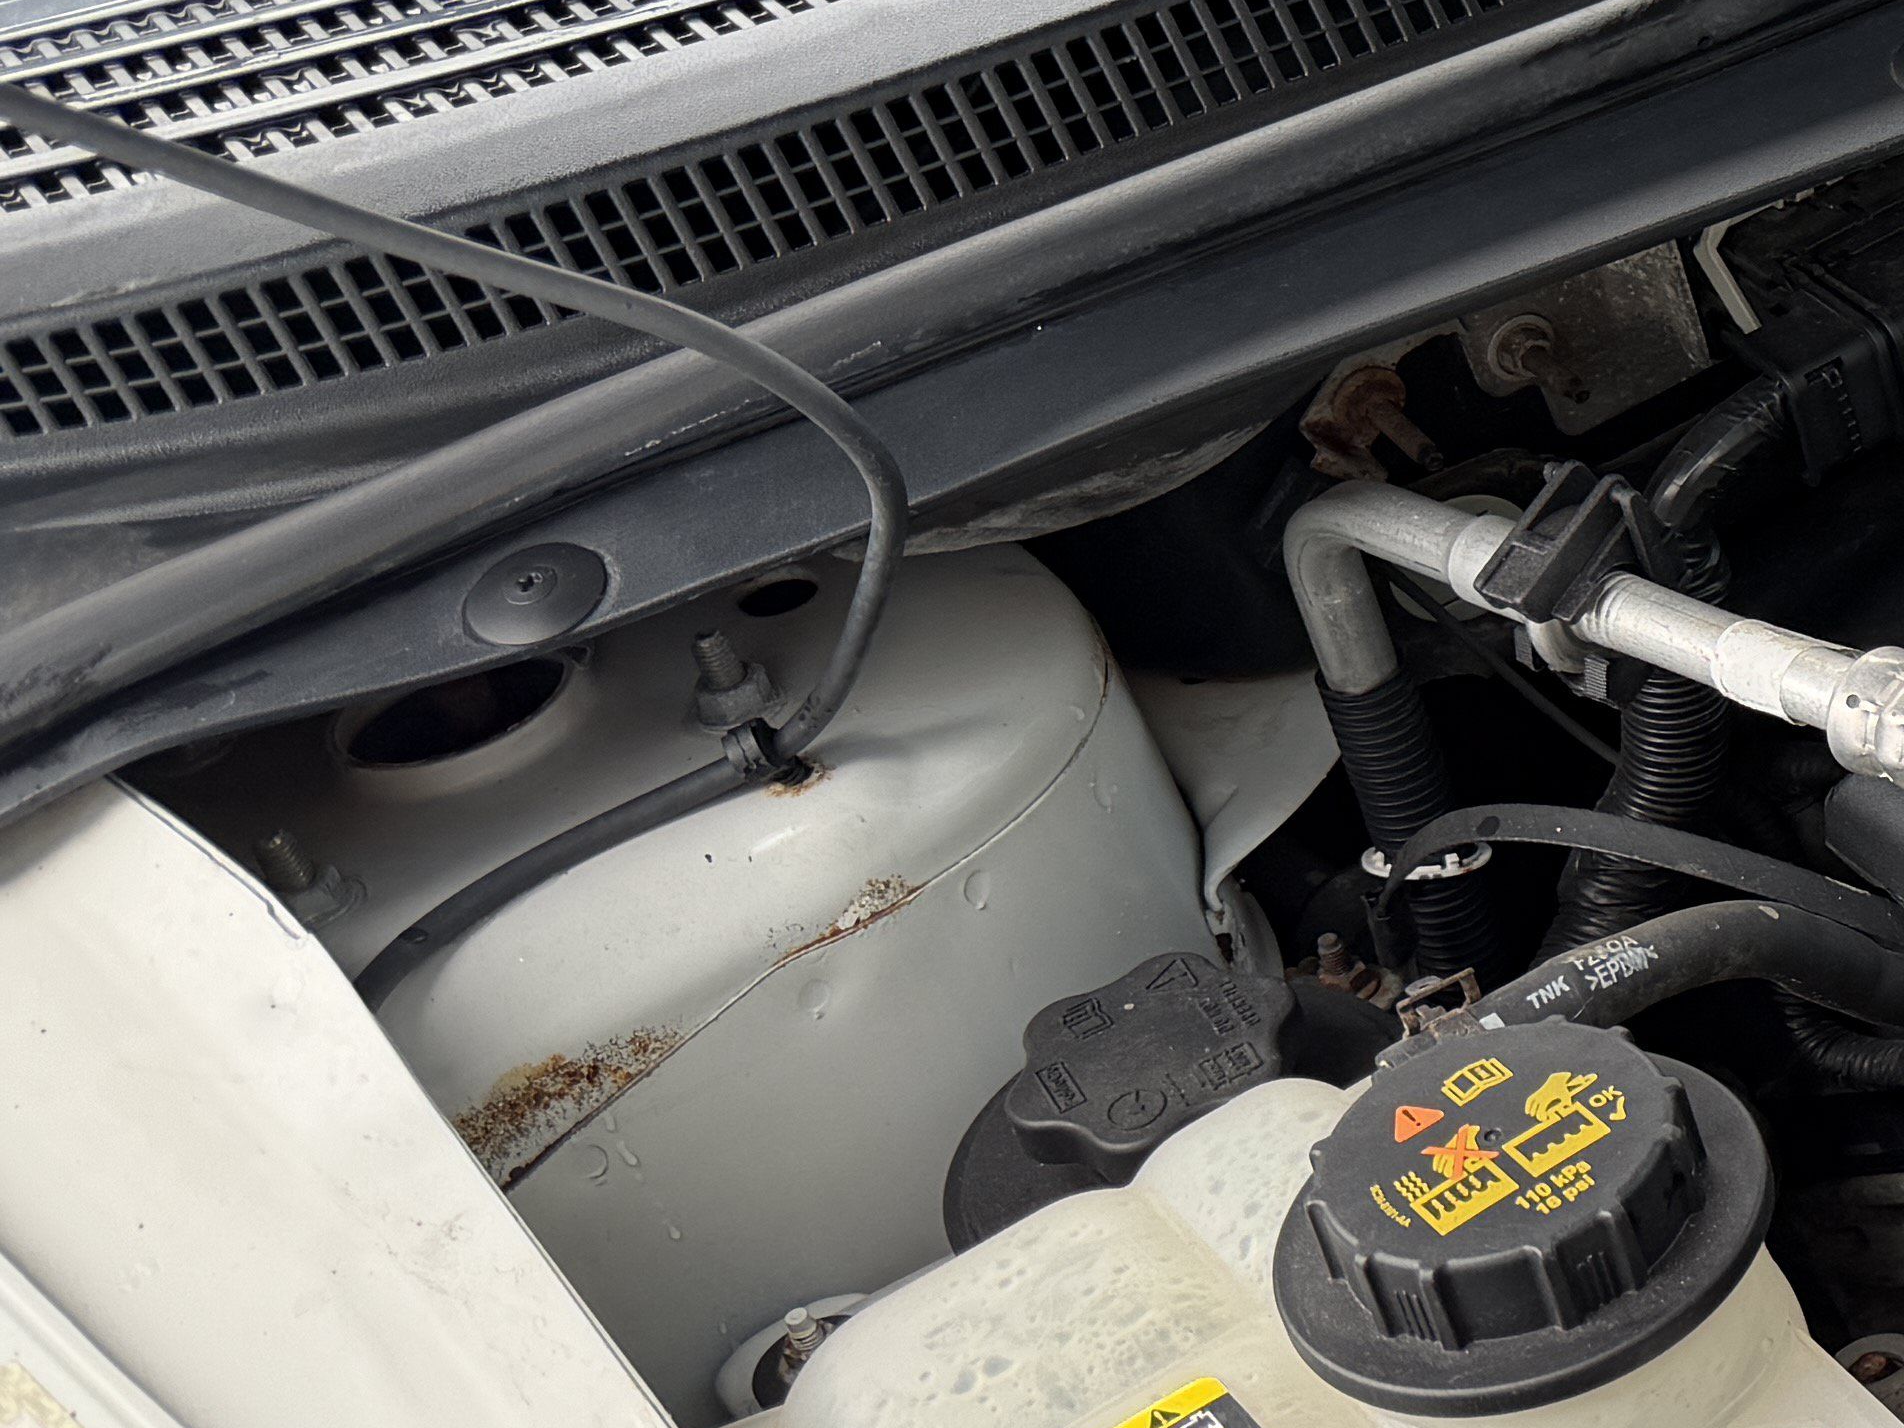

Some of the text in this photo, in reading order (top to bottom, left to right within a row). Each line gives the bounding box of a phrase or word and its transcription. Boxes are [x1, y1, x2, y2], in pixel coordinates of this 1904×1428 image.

[1526, 974, 1571, 1010] TNK
[1588, 1085, 1624, 1108] OK
[1514, 1160, 1593, 1210] 110 kPa
